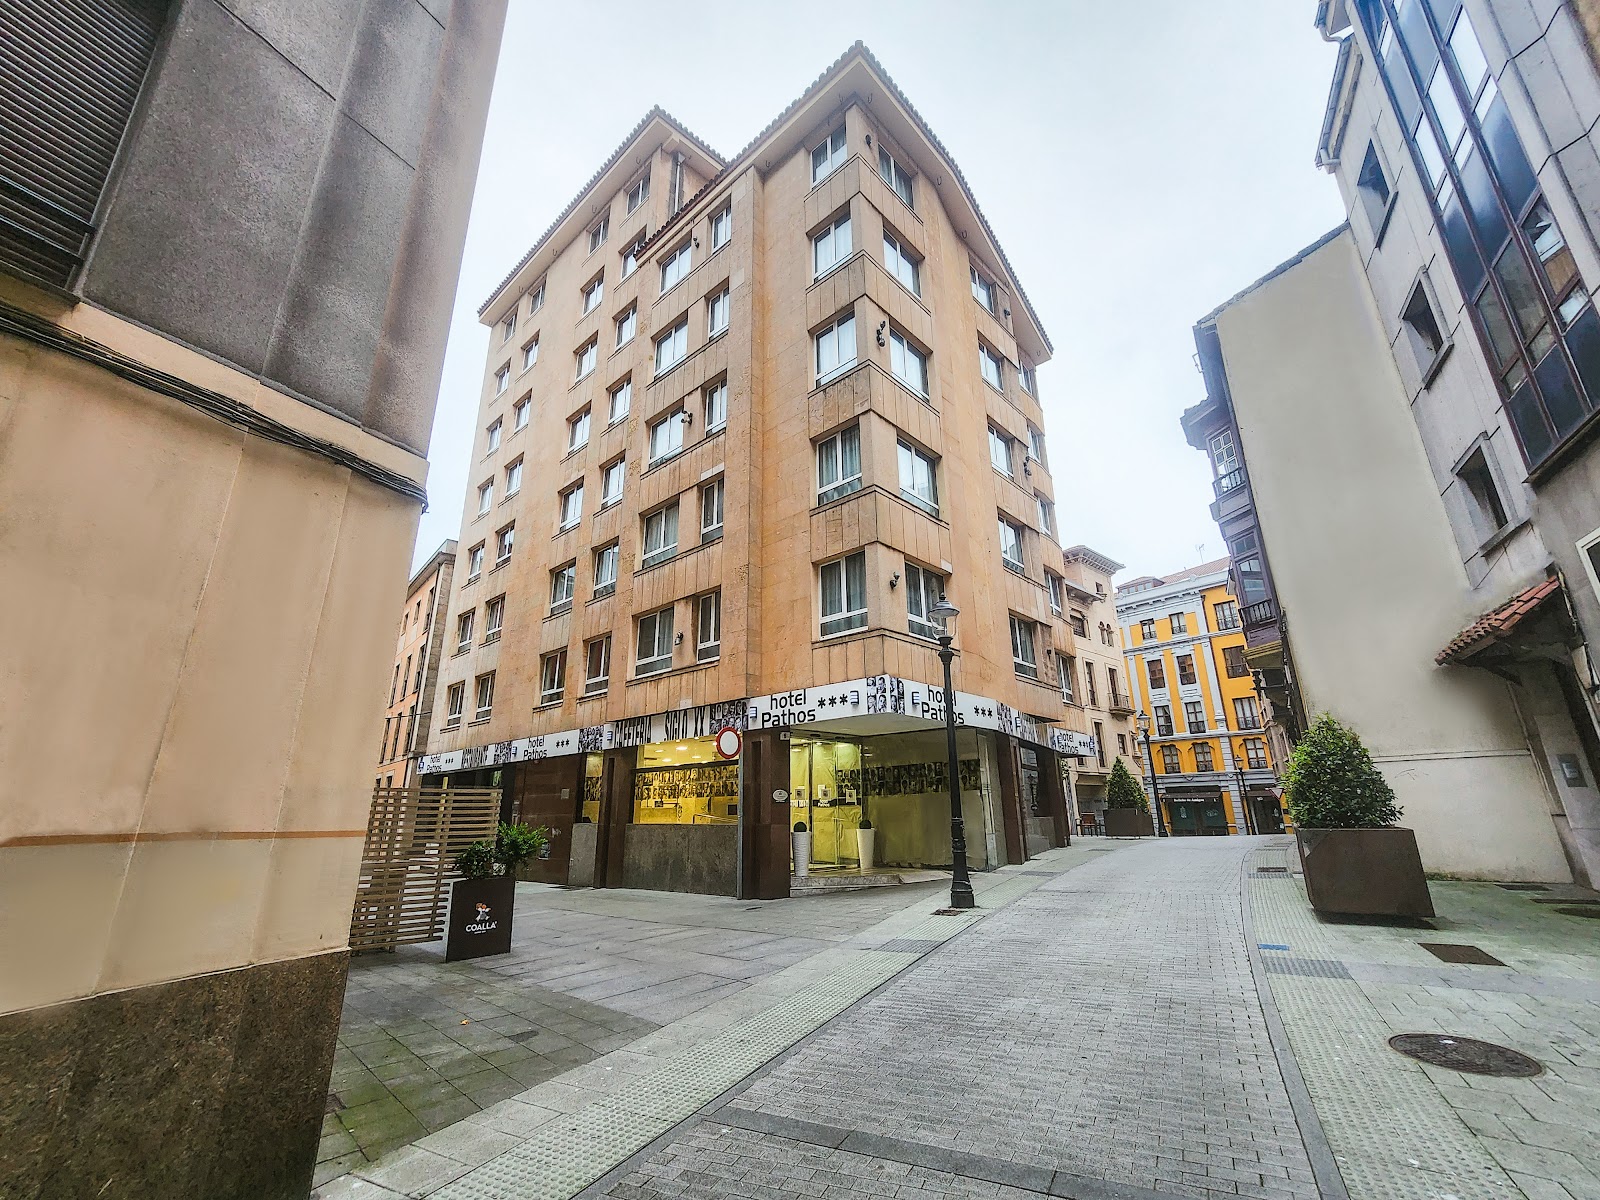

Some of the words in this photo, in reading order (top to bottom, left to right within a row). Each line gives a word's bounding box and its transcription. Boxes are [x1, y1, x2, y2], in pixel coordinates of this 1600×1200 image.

[770, 688, 807, 711] hotel
[927, 684, 957, 707] hotl
[761, 708, 816, 729] Pathos
[528, 735, 545, 749] hotel
[1058, 742, 1079, 754] athos
[523, 748, 548, 762] Pathos
[465, 921, 497, 932] COALLA
